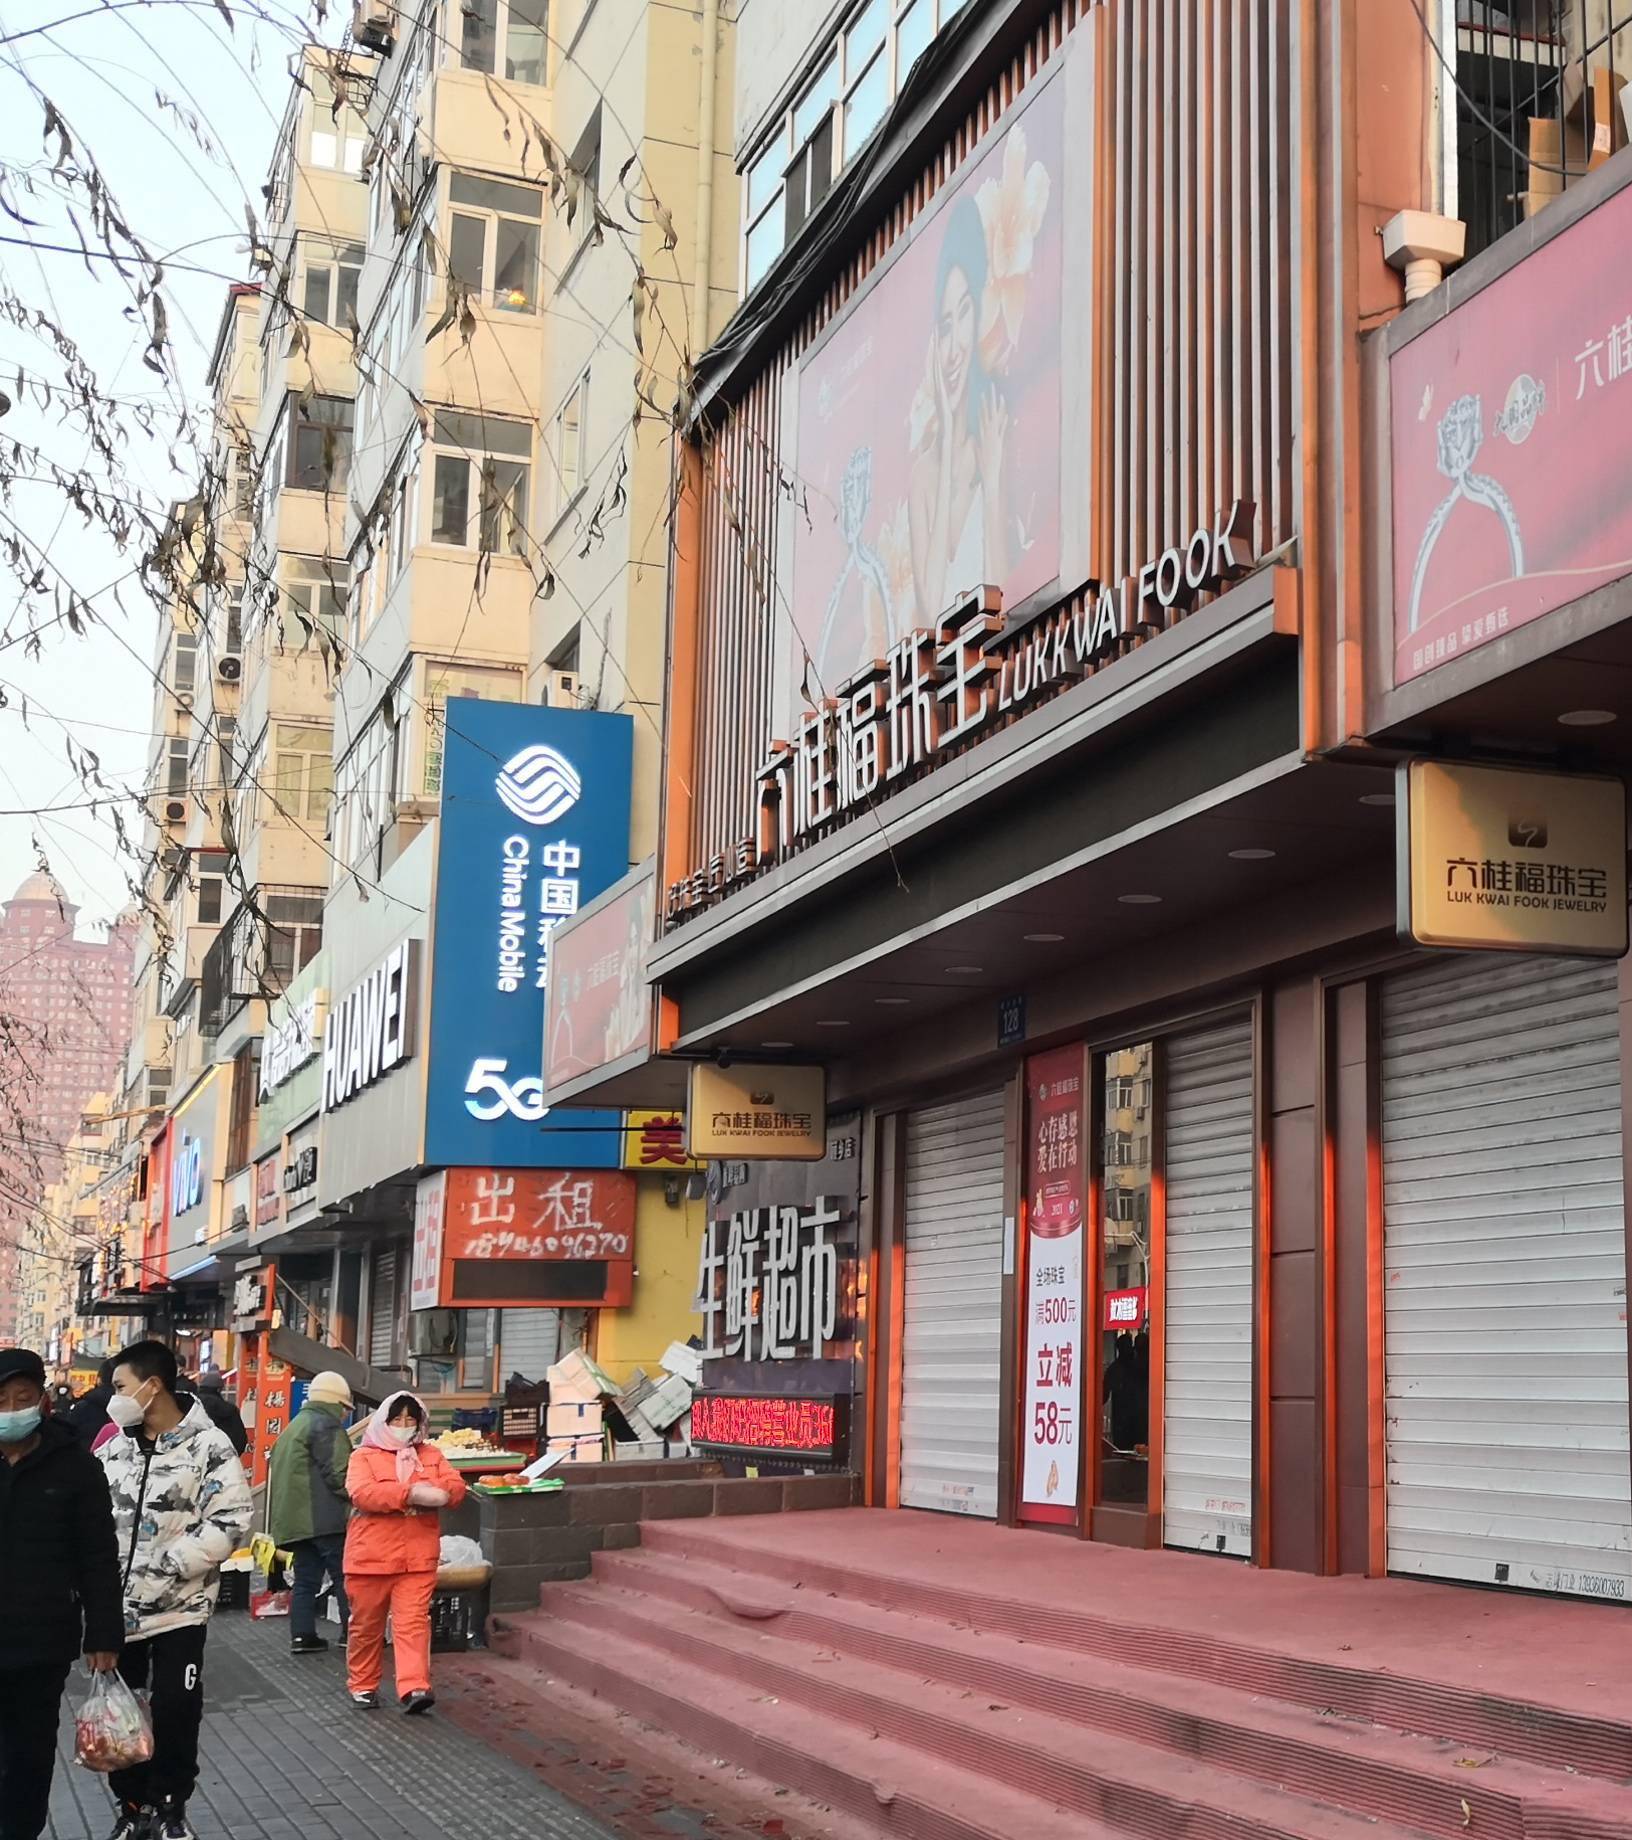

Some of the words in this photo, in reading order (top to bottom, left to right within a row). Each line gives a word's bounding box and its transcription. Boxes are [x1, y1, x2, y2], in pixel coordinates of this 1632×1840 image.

[1138, 500, 1245, 627] FOOK
[755, 584, 1003, 868] 六桂福珠宝
[501, 835, 529, 893] China
[1446, 857, 1607, 899] 六桂福珠宝
[1447, 889, 1473, 904] LUK
[1476, 892, 1510, 906] KWAI
[1513, 895, 1549, 910] FOOK
[1552, 898, 1607, 913] JEWELRY
[497, 910, 526, 993] Mobile
[320, 938, 411, 1114] HUAWEI
[464, 1057, 551, 1122] 5G
[712, 1112, 811, 1129] 六桂福珠宝
[470, 1172, 603, 1231] 出租
[694, 1195, 841, 1363] 生鲜超市
[1036, 1342, 1073, 1389] 立减
[1033, 1400, 1073, 1446] 58元
[184, 1663, 197, 1692] G
